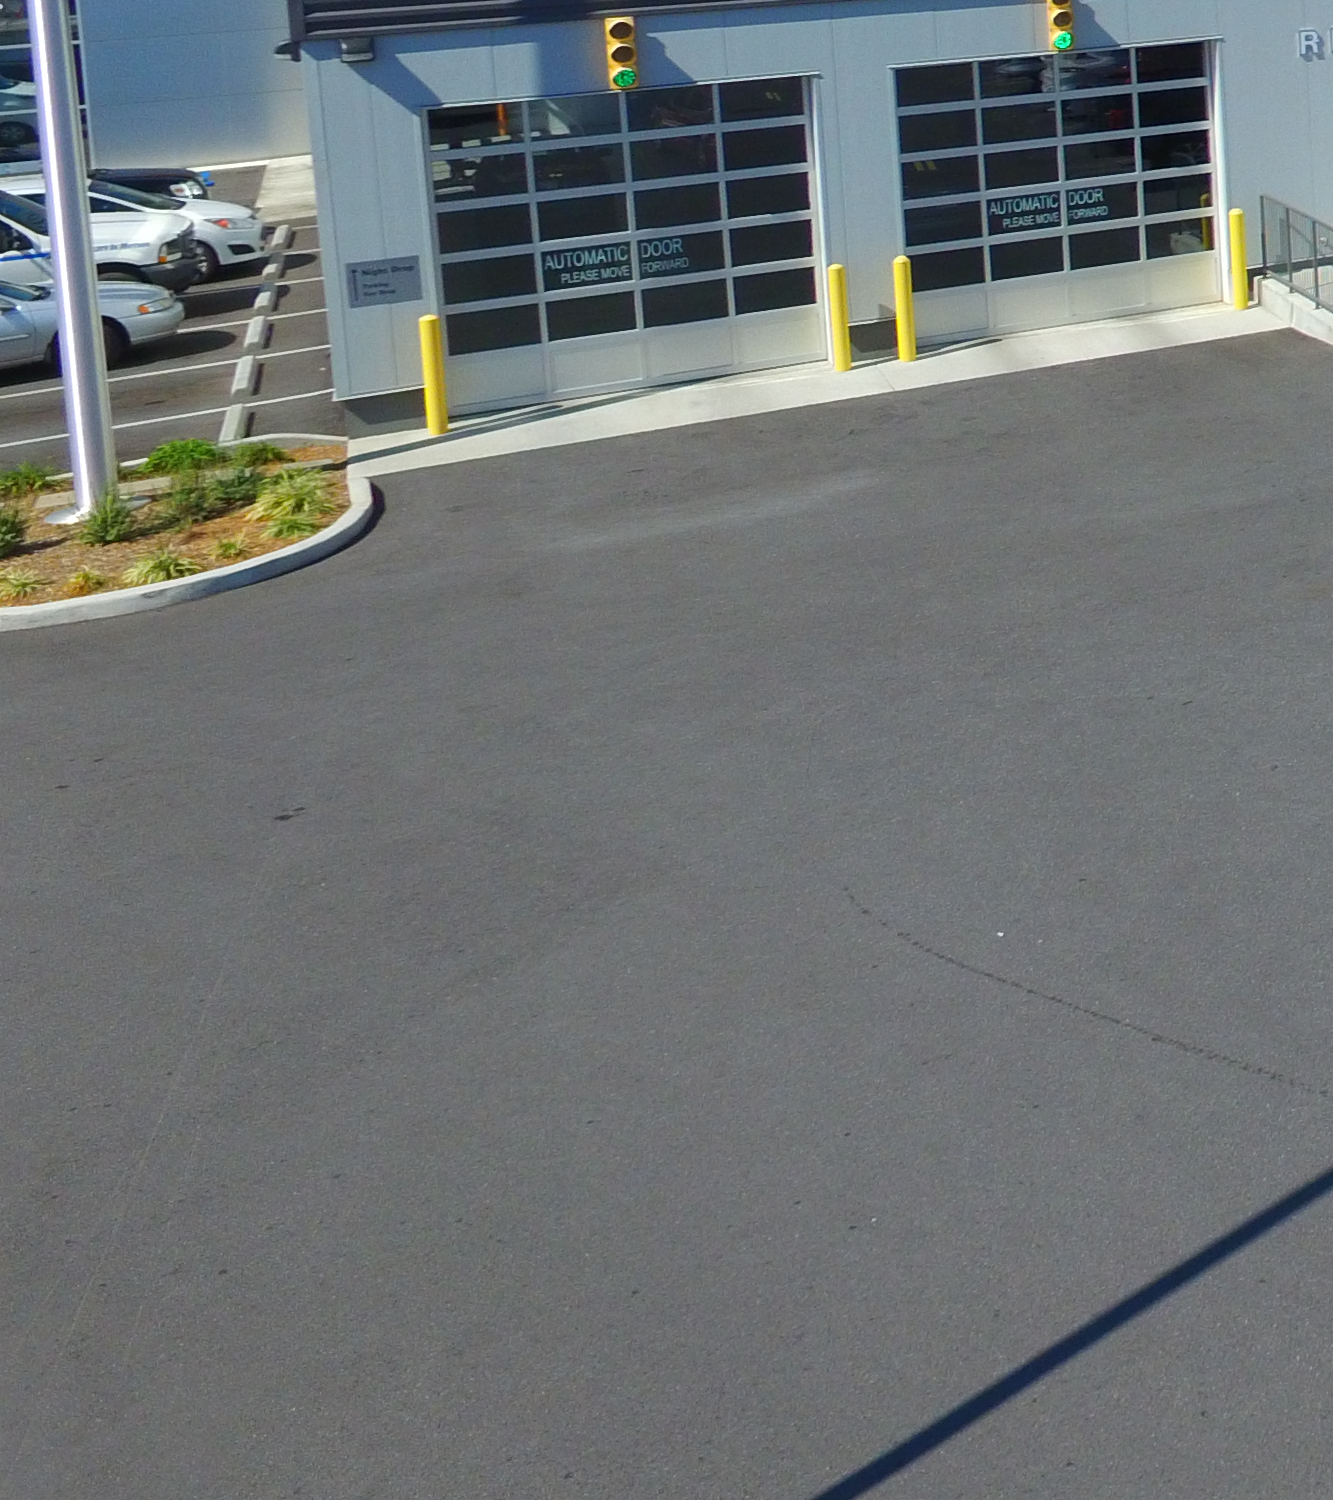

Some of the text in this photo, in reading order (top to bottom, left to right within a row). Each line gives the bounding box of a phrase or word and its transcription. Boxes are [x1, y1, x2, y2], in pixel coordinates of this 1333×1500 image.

[989, 188, 1104, 216] AUTOMATIC DOOR
[1002, 205, 1109, 229] PLEASE MOVE FORWARD
[544, 238, 684, 270] AUTOMATIC DOOR
[560, 257, 689, 284] PLEASE MOVE FORWARD
